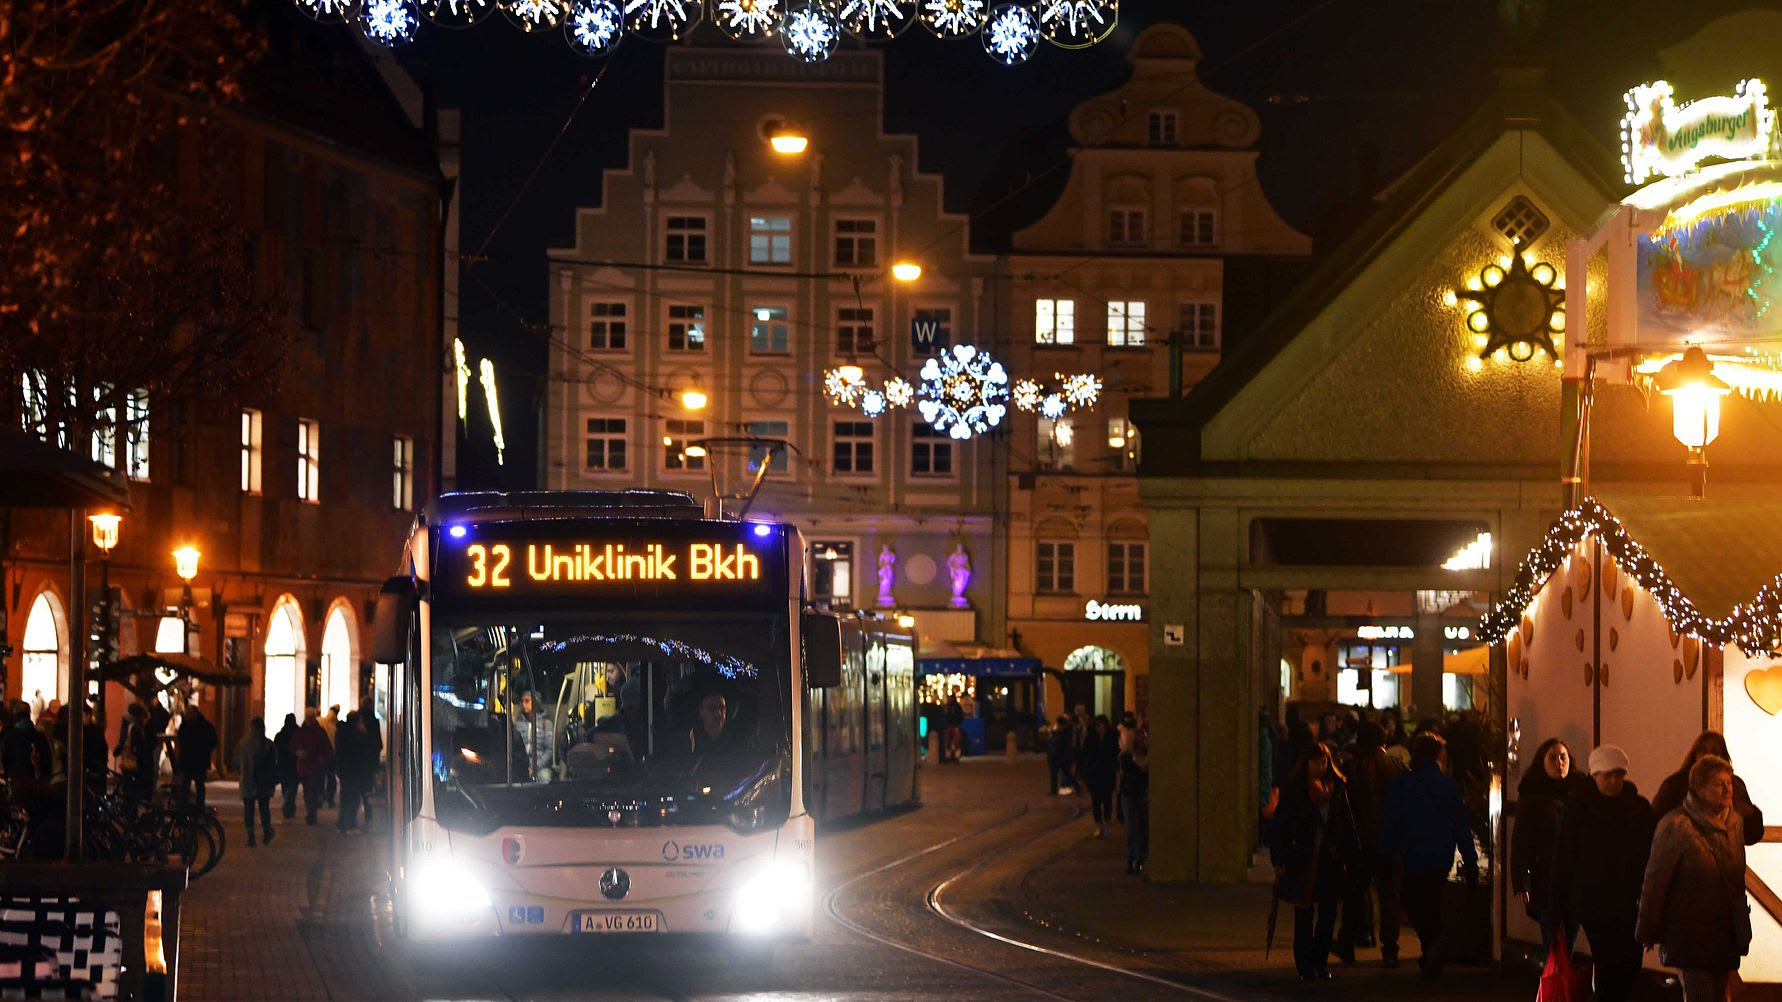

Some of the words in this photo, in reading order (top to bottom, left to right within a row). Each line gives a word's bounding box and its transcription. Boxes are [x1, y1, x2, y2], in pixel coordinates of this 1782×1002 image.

[1668, 110, 1748, 150] Augsburger
[915, 321, 937, 343] W
[467, 544, 511, 587] 32
[528, 543, 677, 581] Uniklinik
[690, 543, 759, 580] Bkh
[1085, 599, 1141, 621] Stern
[682, 844, 725, 859] swa
[585, 916, 594, 930] A
[605, 916, 623, 930] VG
[627, 916, 652, 930] 610
